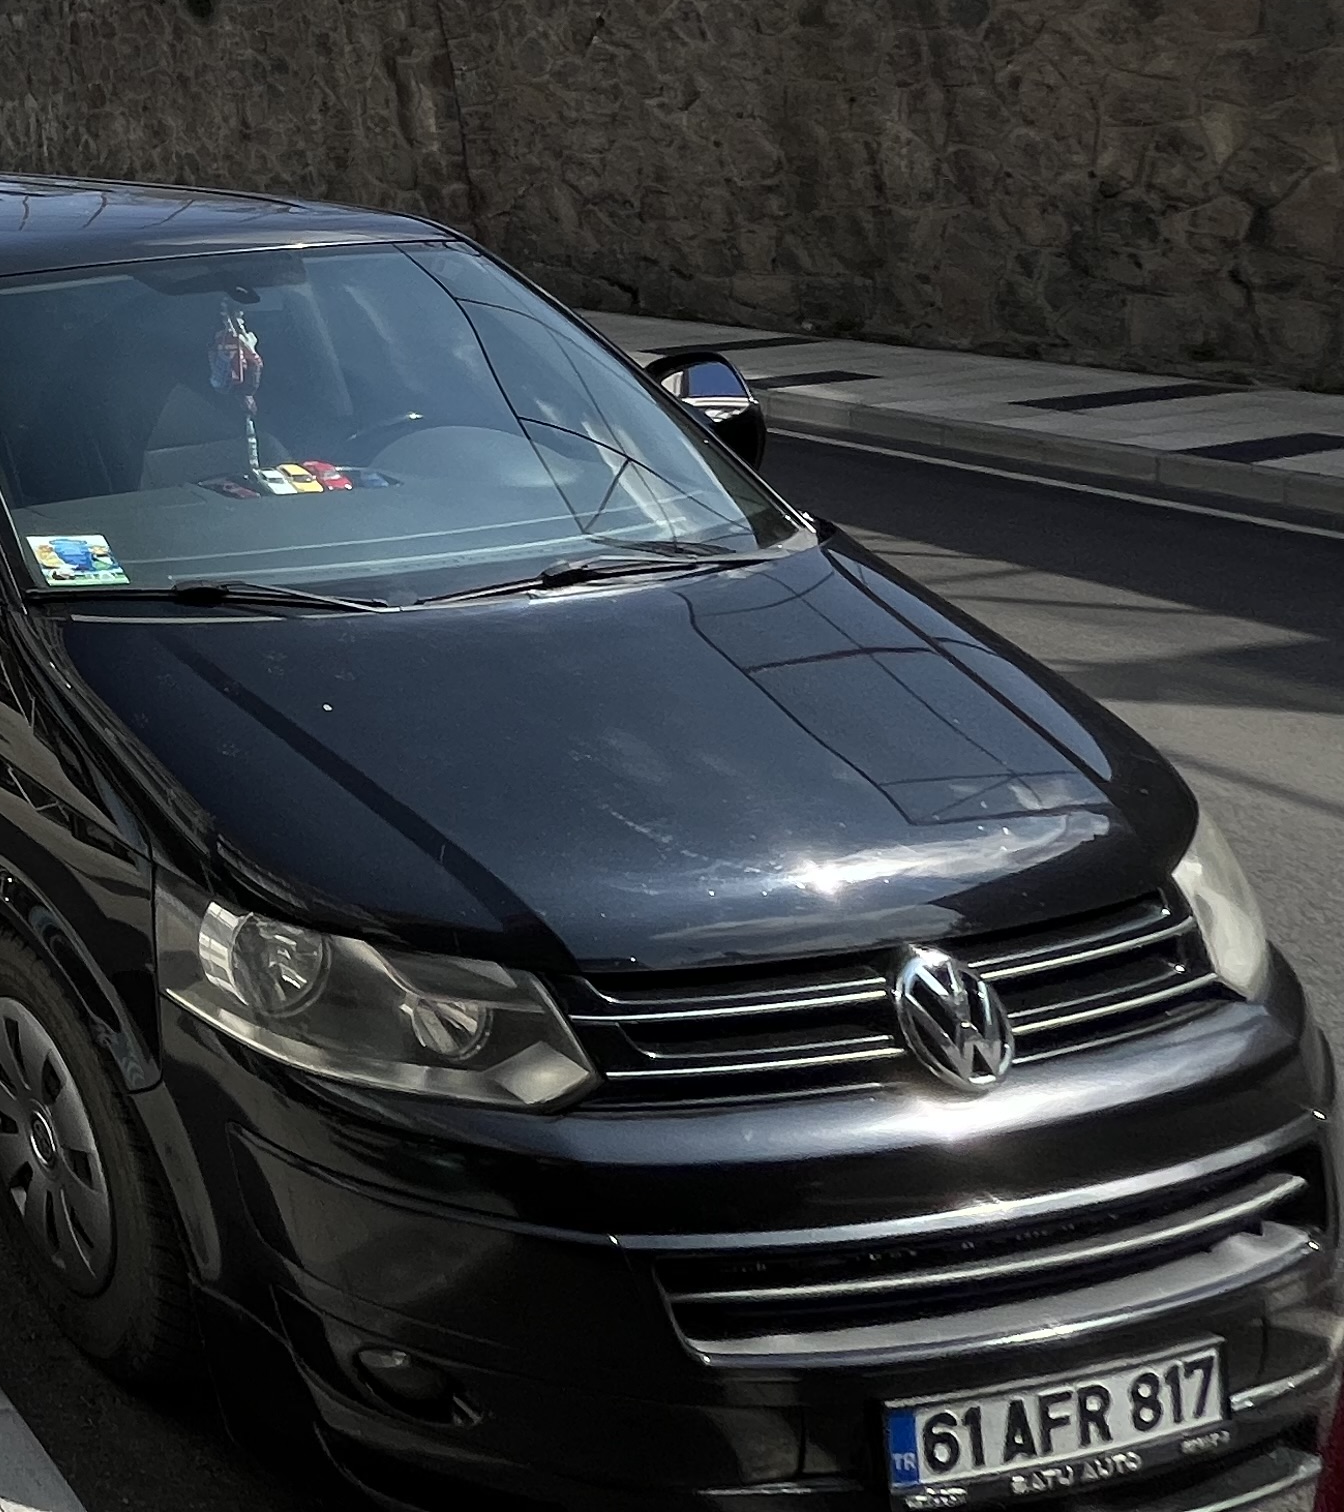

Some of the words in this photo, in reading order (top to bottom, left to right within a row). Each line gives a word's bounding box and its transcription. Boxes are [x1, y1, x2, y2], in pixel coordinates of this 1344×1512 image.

[923, 1406, 986, 1473] 61
[1002, 1384, 1113, 1464] AFR
[1131, 1356, 1215, 1432] 817
